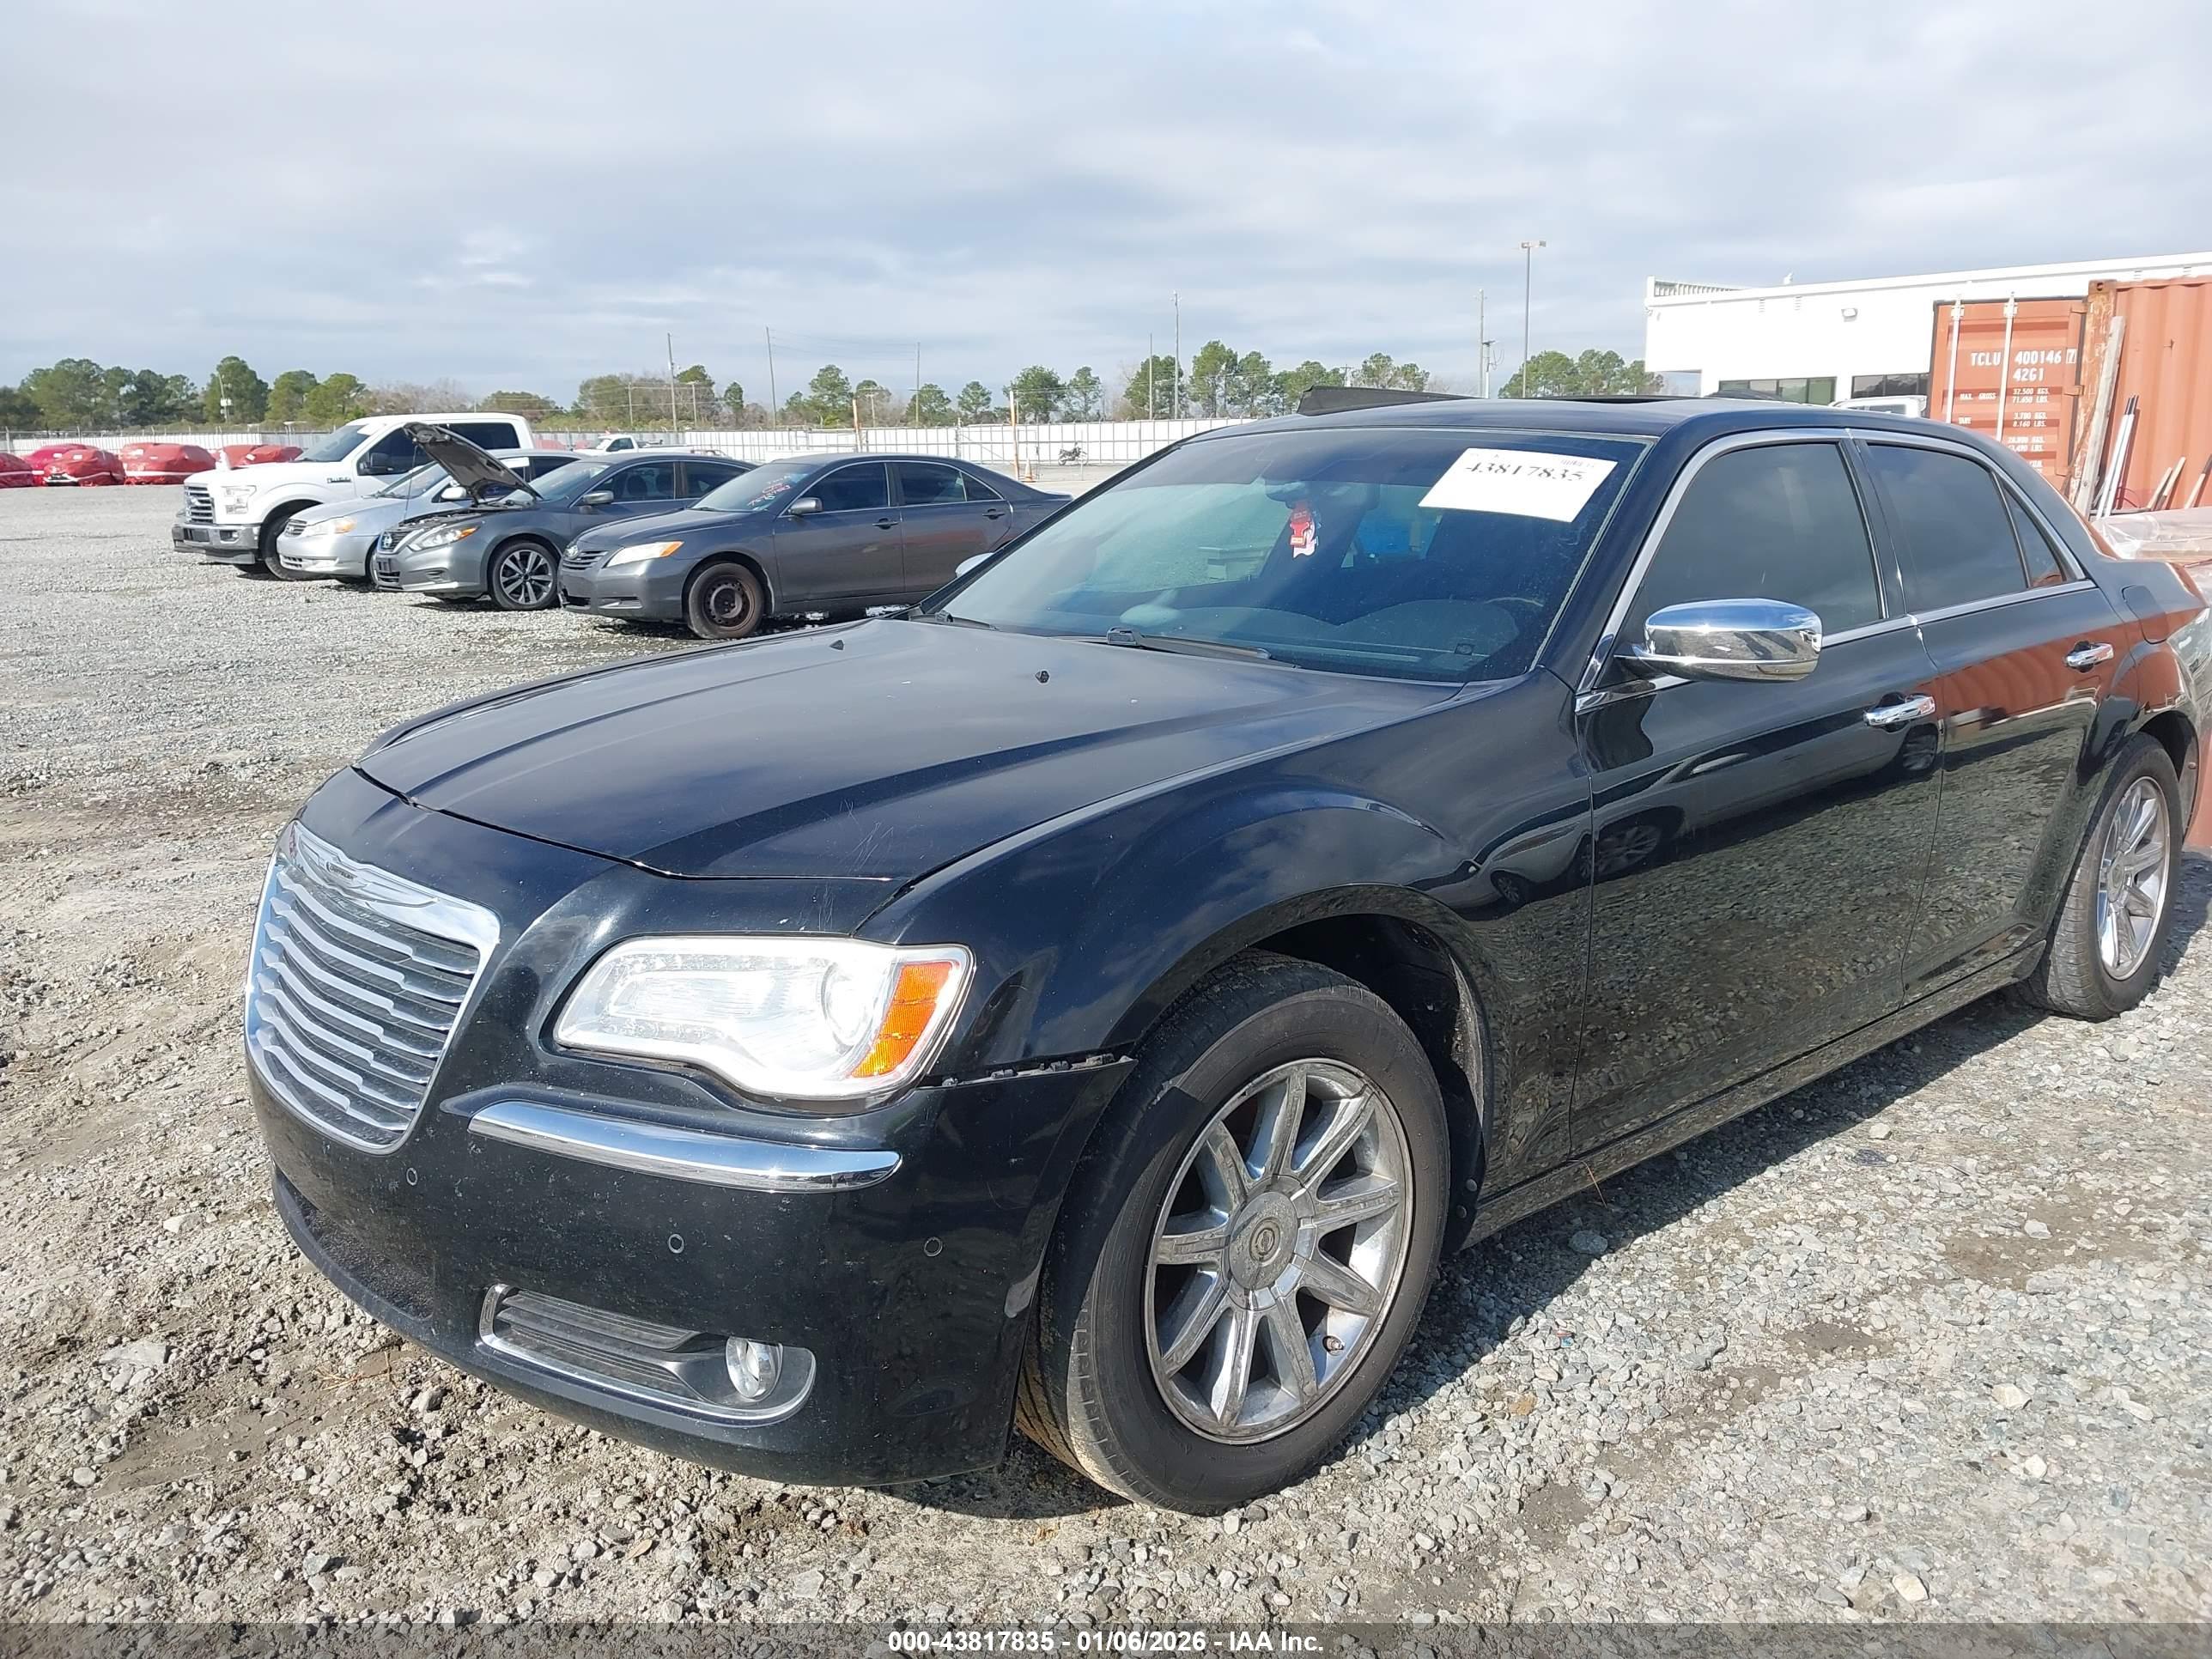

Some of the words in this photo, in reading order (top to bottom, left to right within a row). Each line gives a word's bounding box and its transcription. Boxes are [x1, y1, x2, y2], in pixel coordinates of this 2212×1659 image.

[1971, 351, 2002, 366] TCLU
[2014, 349, 2062, 365] 400146
[2066, 349, 2077, 364] 7
[2013, 368, 2045, 381] 42G1
[1465, 461, 1587, 482] 43817835
